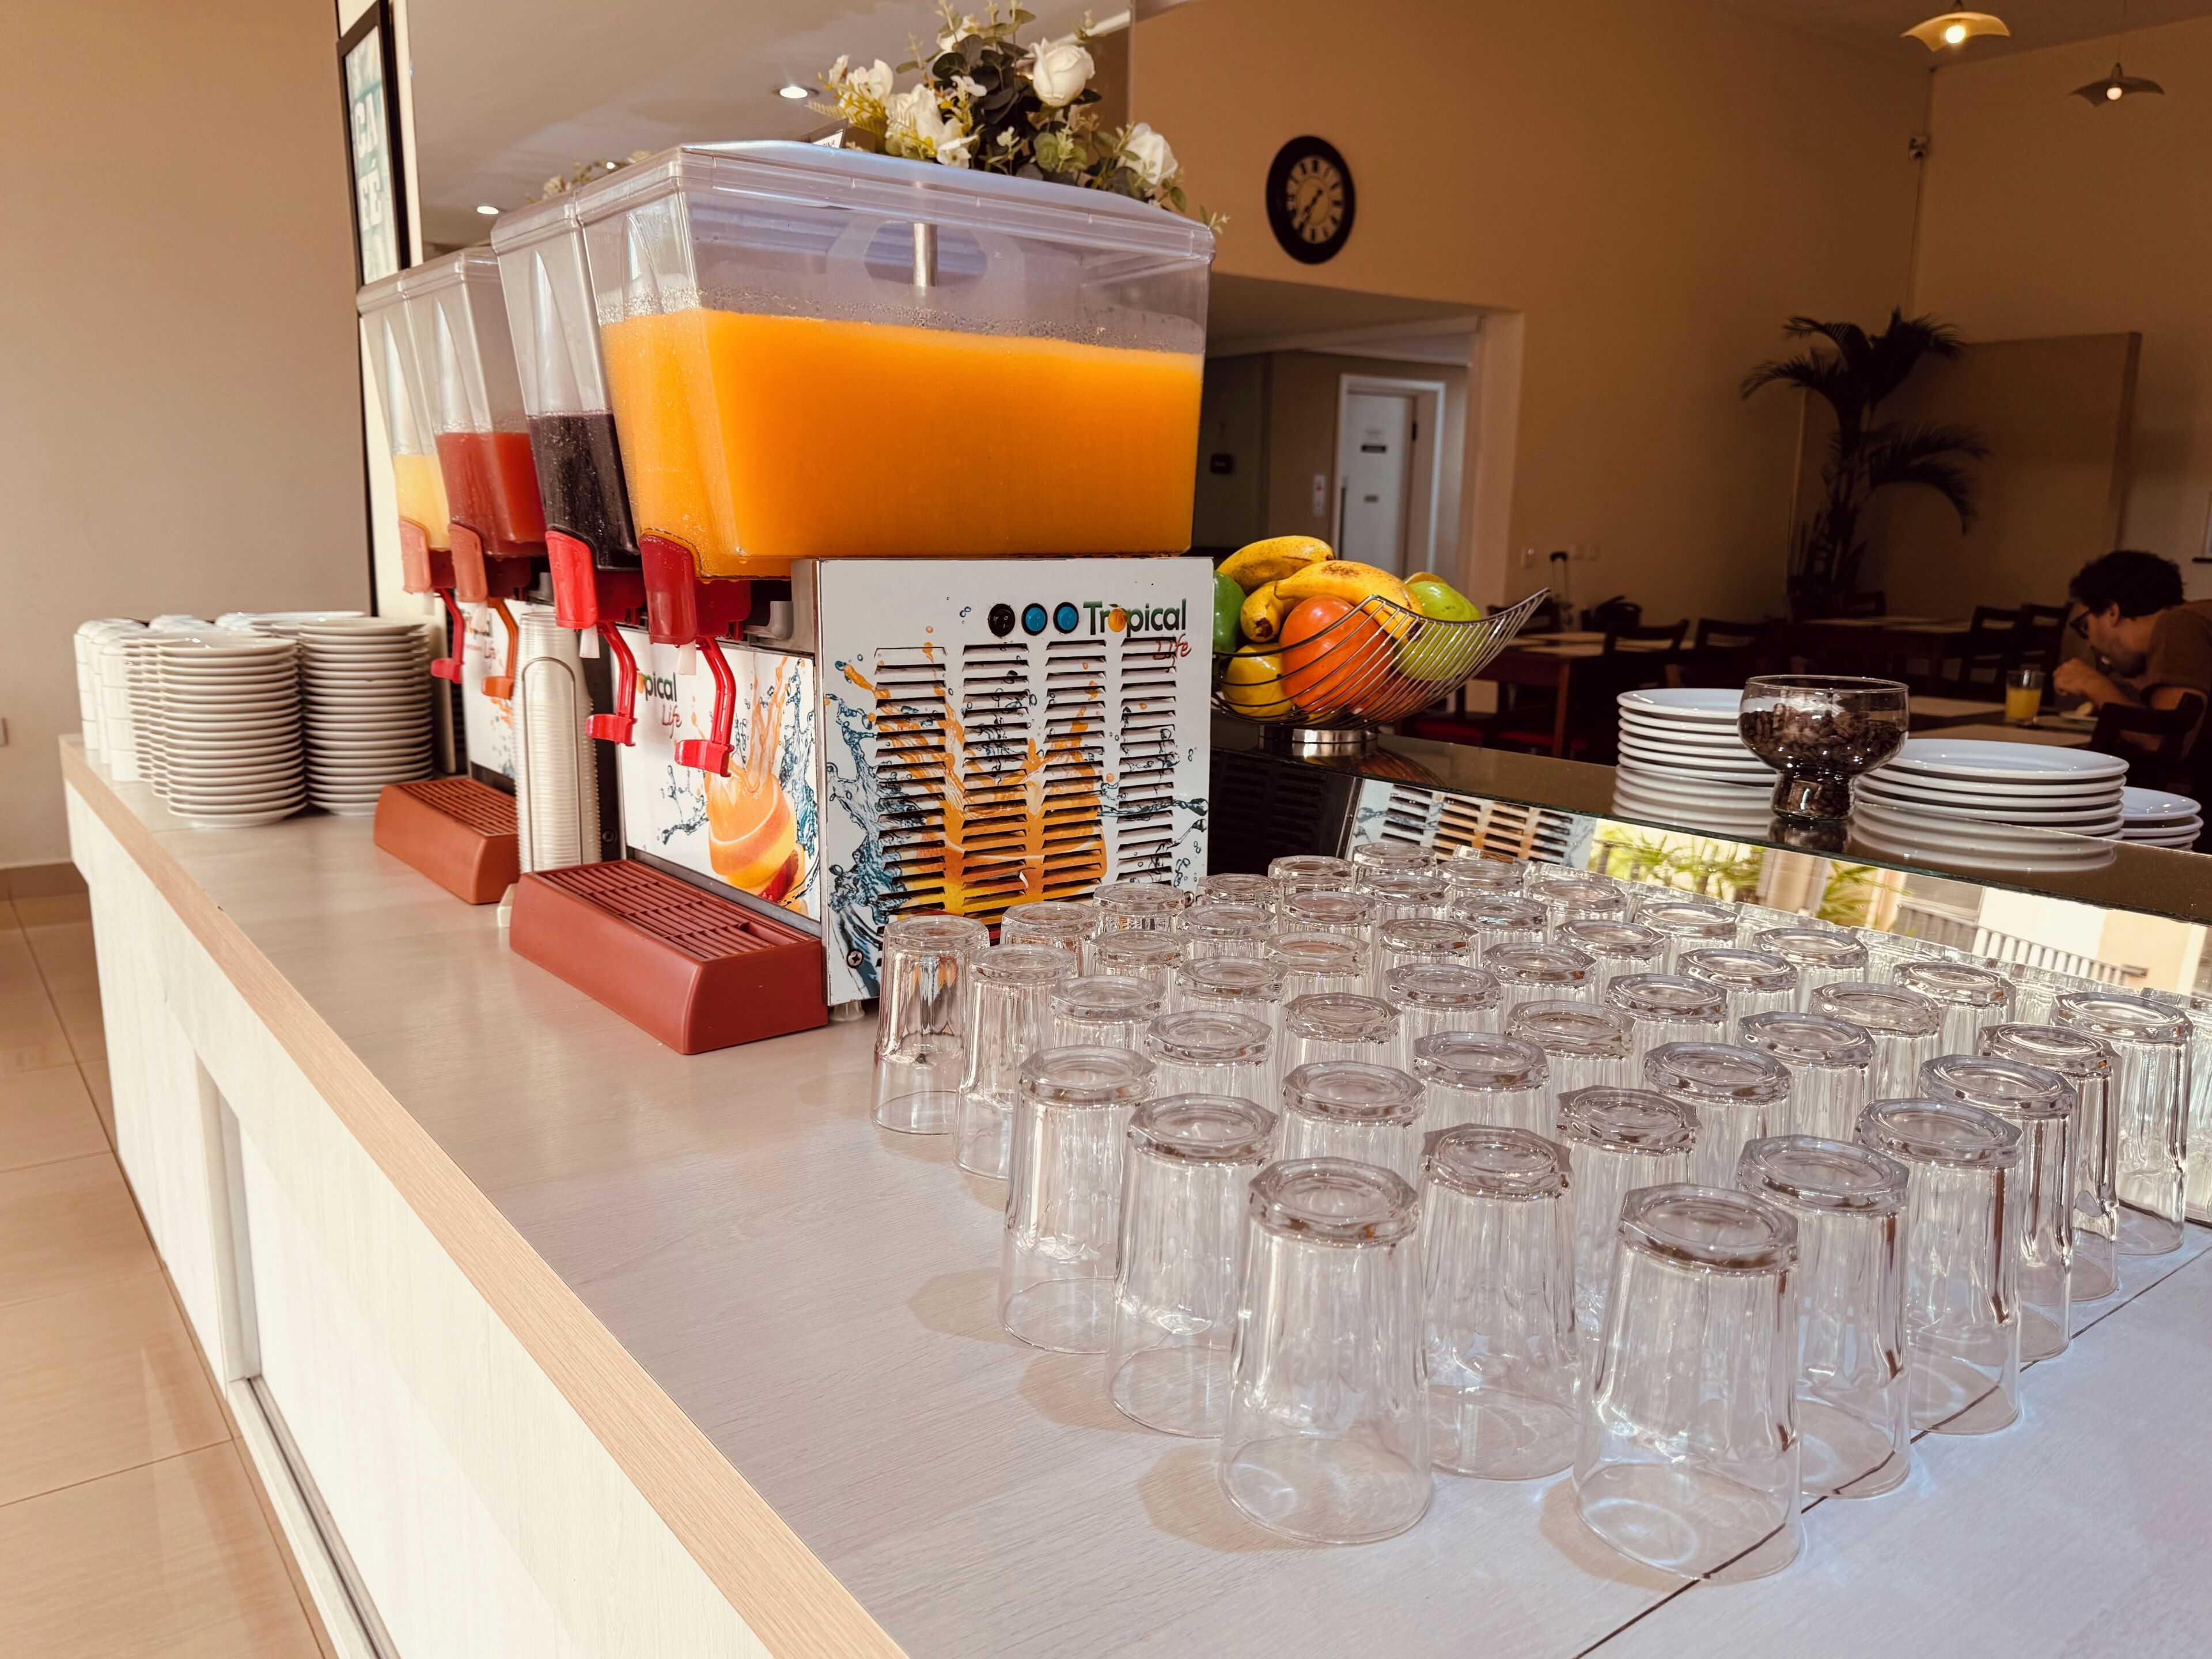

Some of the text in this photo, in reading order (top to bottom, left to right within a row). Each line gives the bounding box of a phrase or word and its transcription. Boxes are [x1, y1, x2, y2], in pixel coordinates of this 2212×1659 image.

[354, 92, 378, 159] CA
[1083, 598, 1187, 638] Tropical
[661, 704, 683, 739] Life
